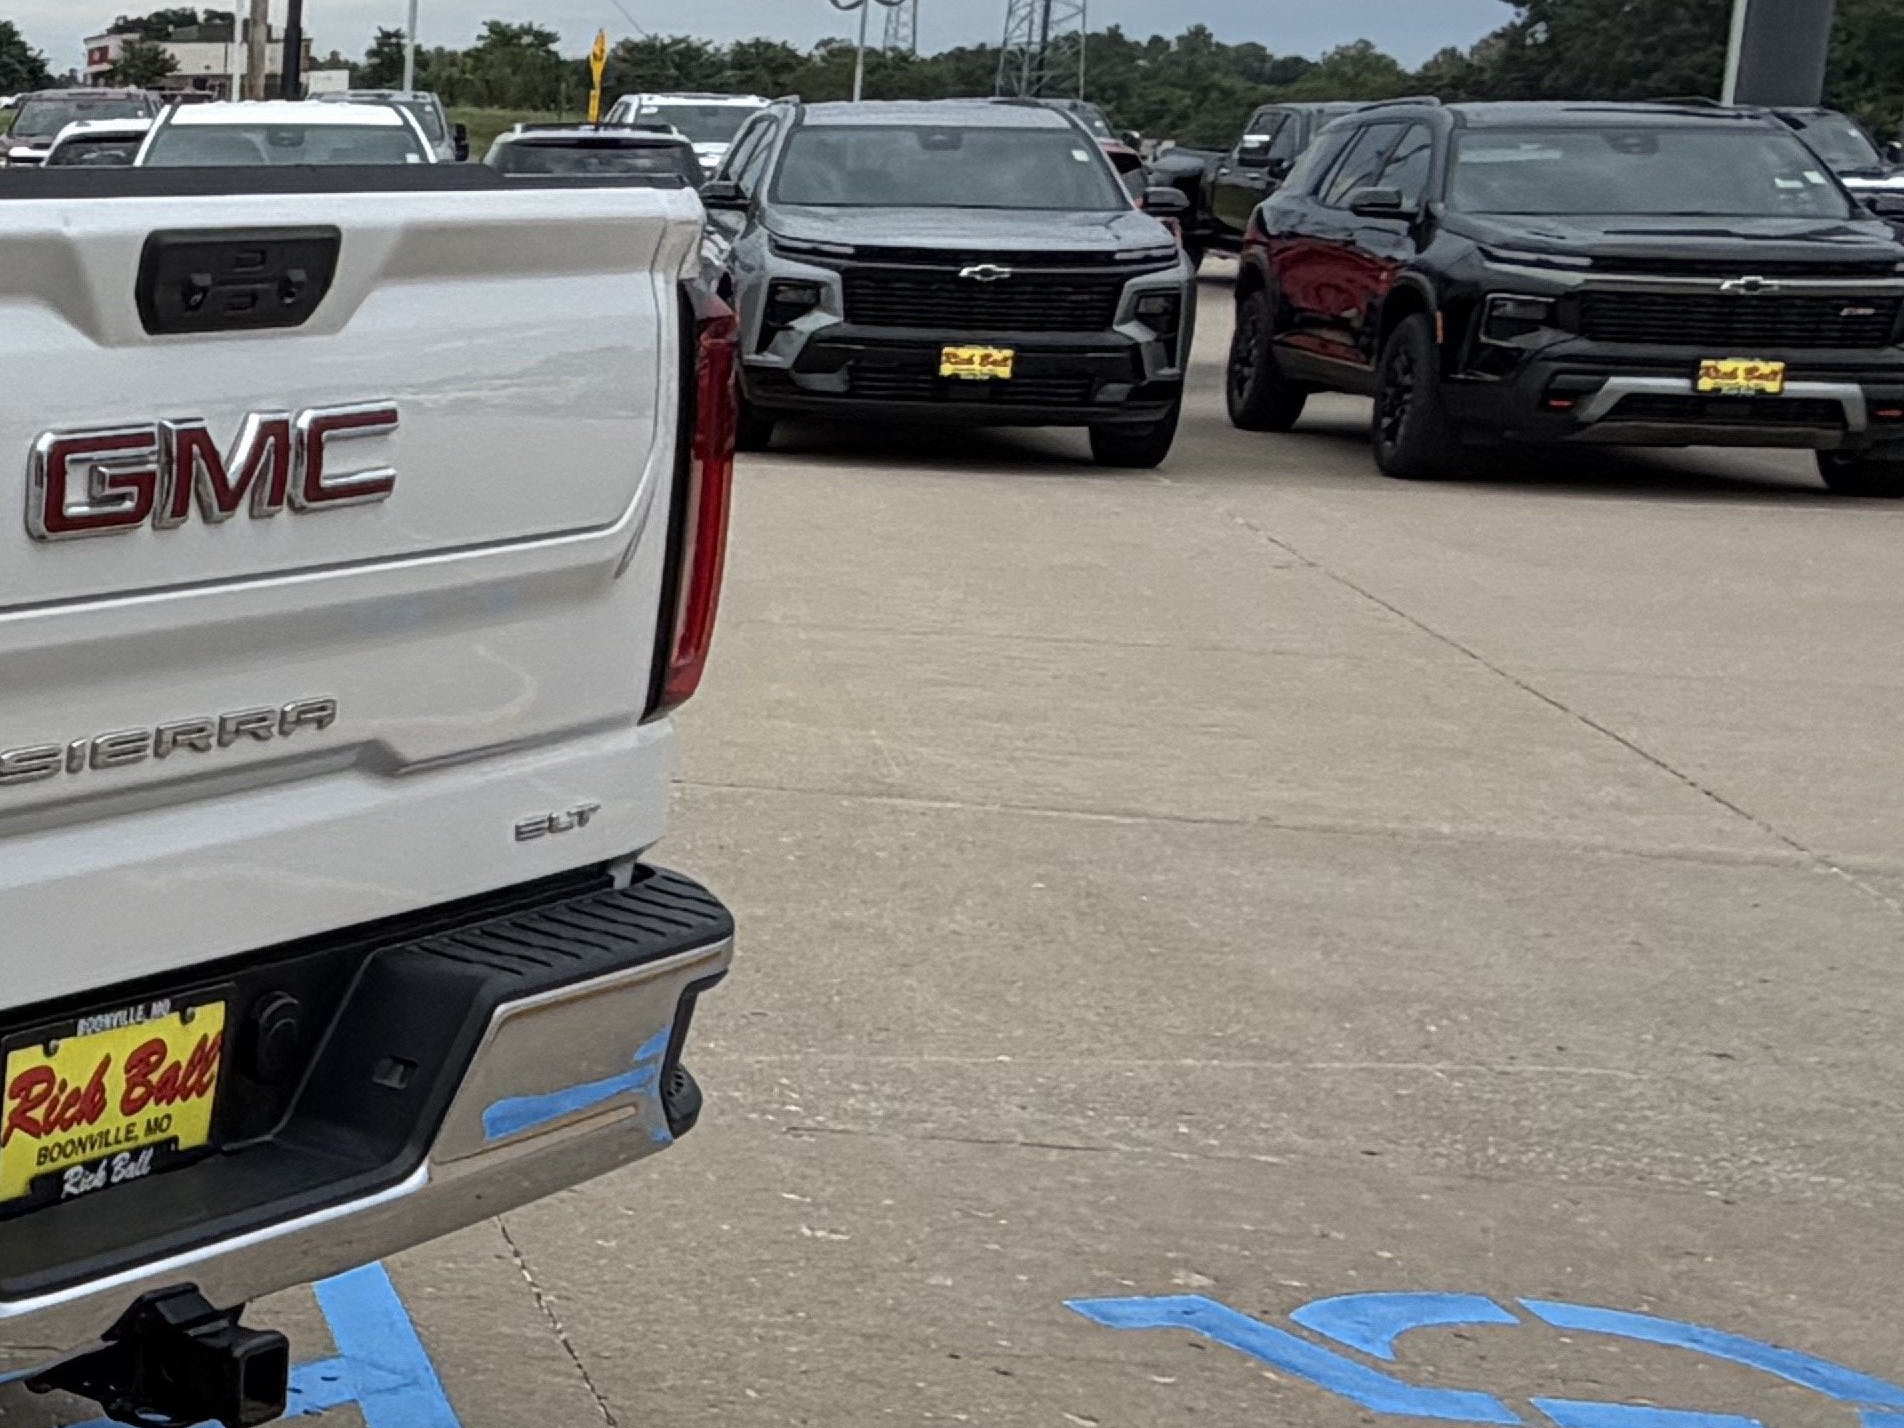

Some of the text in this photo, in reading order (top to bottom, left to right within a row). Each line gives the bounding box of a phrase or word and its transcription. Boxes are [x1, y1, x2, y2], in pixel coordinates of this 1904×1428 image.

[25, 399, 399, 542] GMC
[0, 1032, 224, 1148] Rick Ball
[35, 1113, 173, 1167] BOONVILLE, MO
[61, 1146, 155, 1200] Rick Ball
